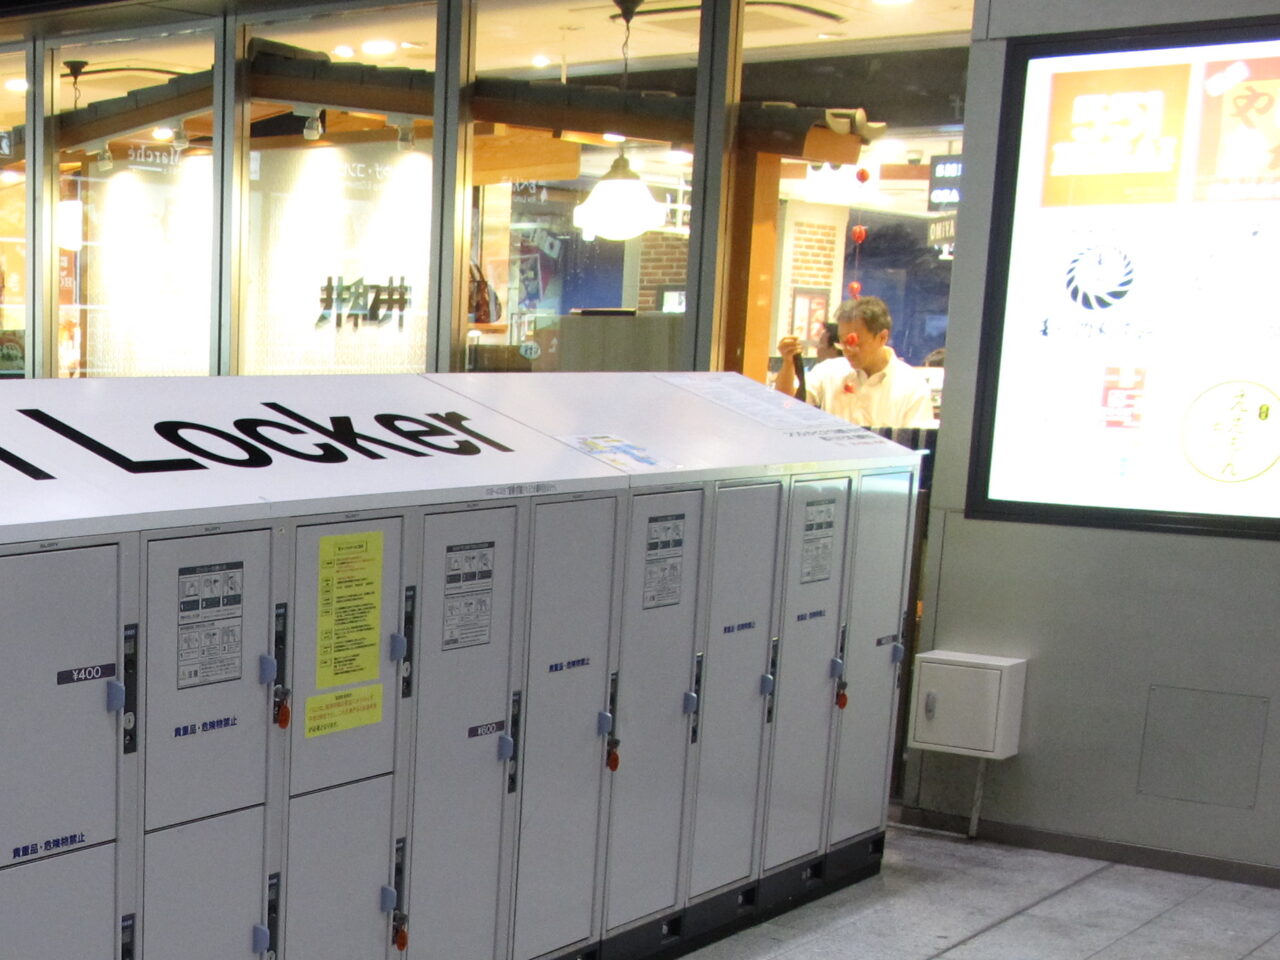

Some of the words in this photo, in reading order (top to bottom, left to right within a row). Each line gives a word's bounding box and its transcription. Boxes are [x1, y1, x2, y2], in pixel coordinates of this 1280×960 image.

[17, 402, 515, 475] Locker
[72, 666, 102, 681] ¥400
[12, 833, 86, 859] 貴重品・危険物禁止
